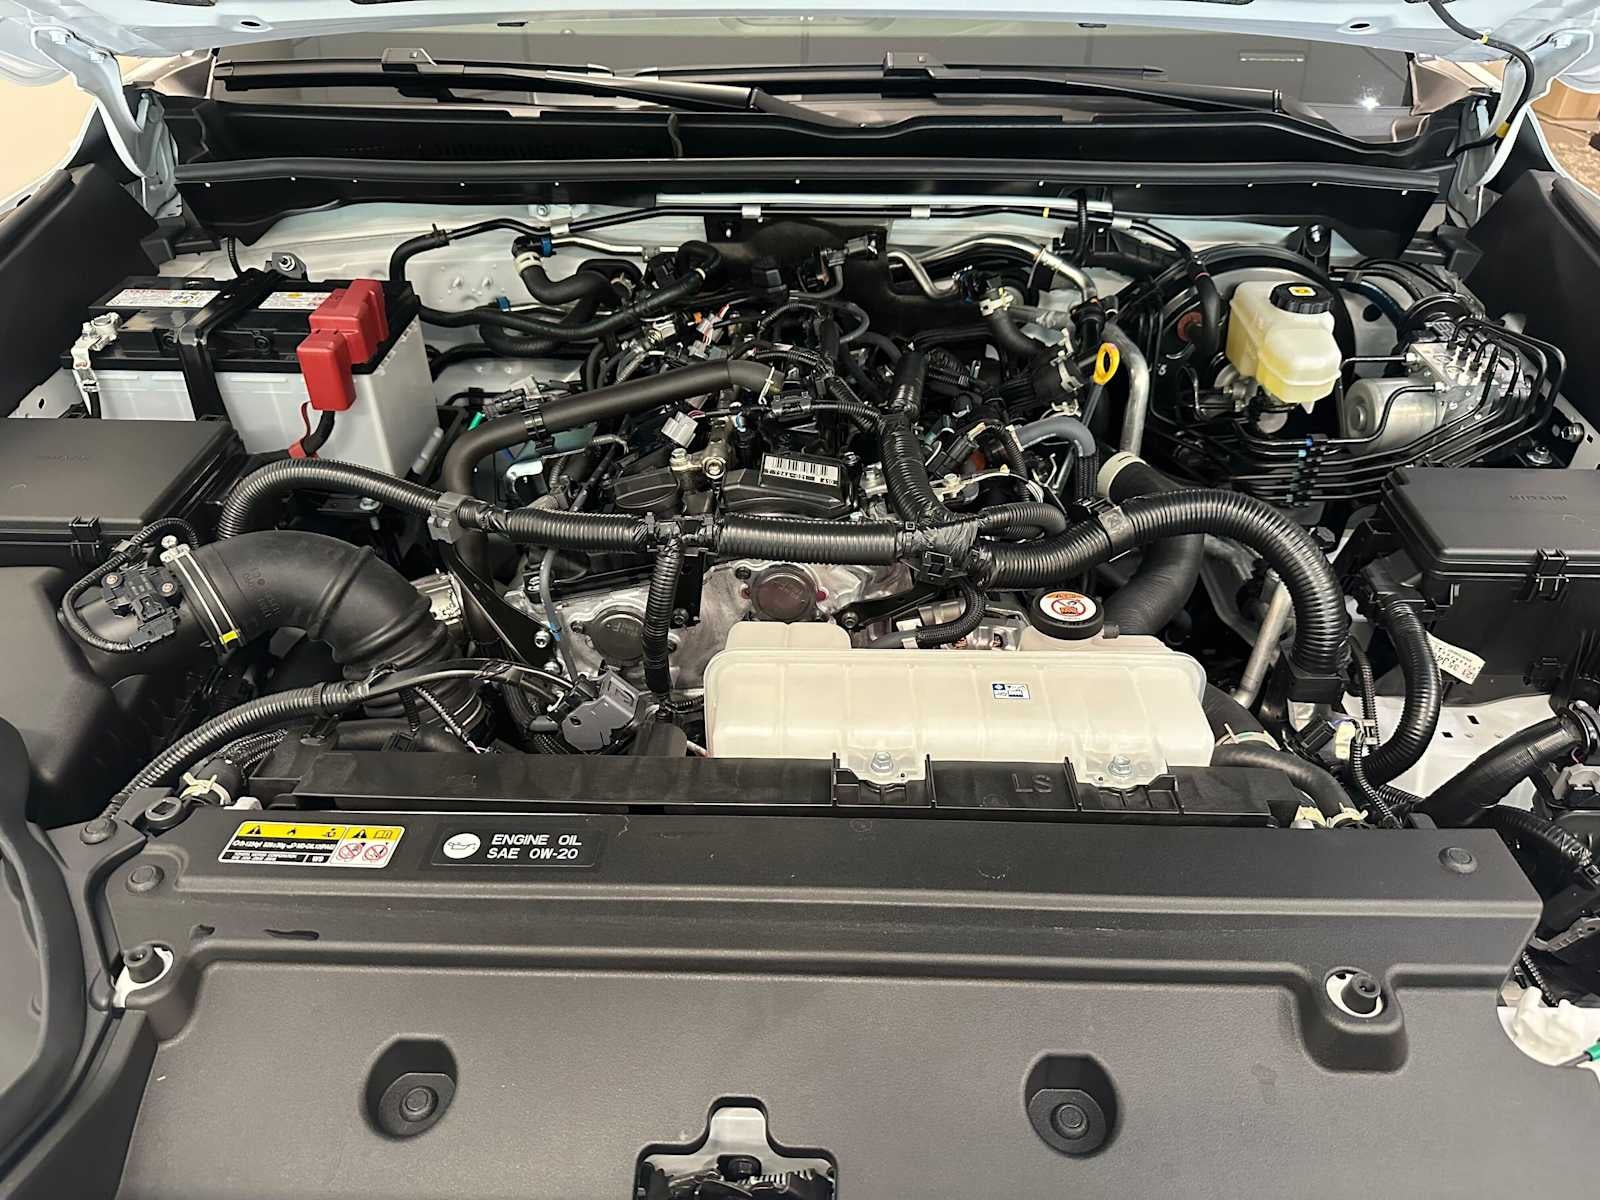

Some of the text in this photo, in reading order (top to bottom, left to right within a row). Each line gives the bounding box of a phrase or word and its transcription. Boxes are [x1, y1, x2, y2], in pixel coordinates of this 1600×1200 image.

[1012, 773, 1053, 793] LS
[491, 833, 583, 847] ENGINE OIL
[486, 847, 579, 860] SAE 0W-20
